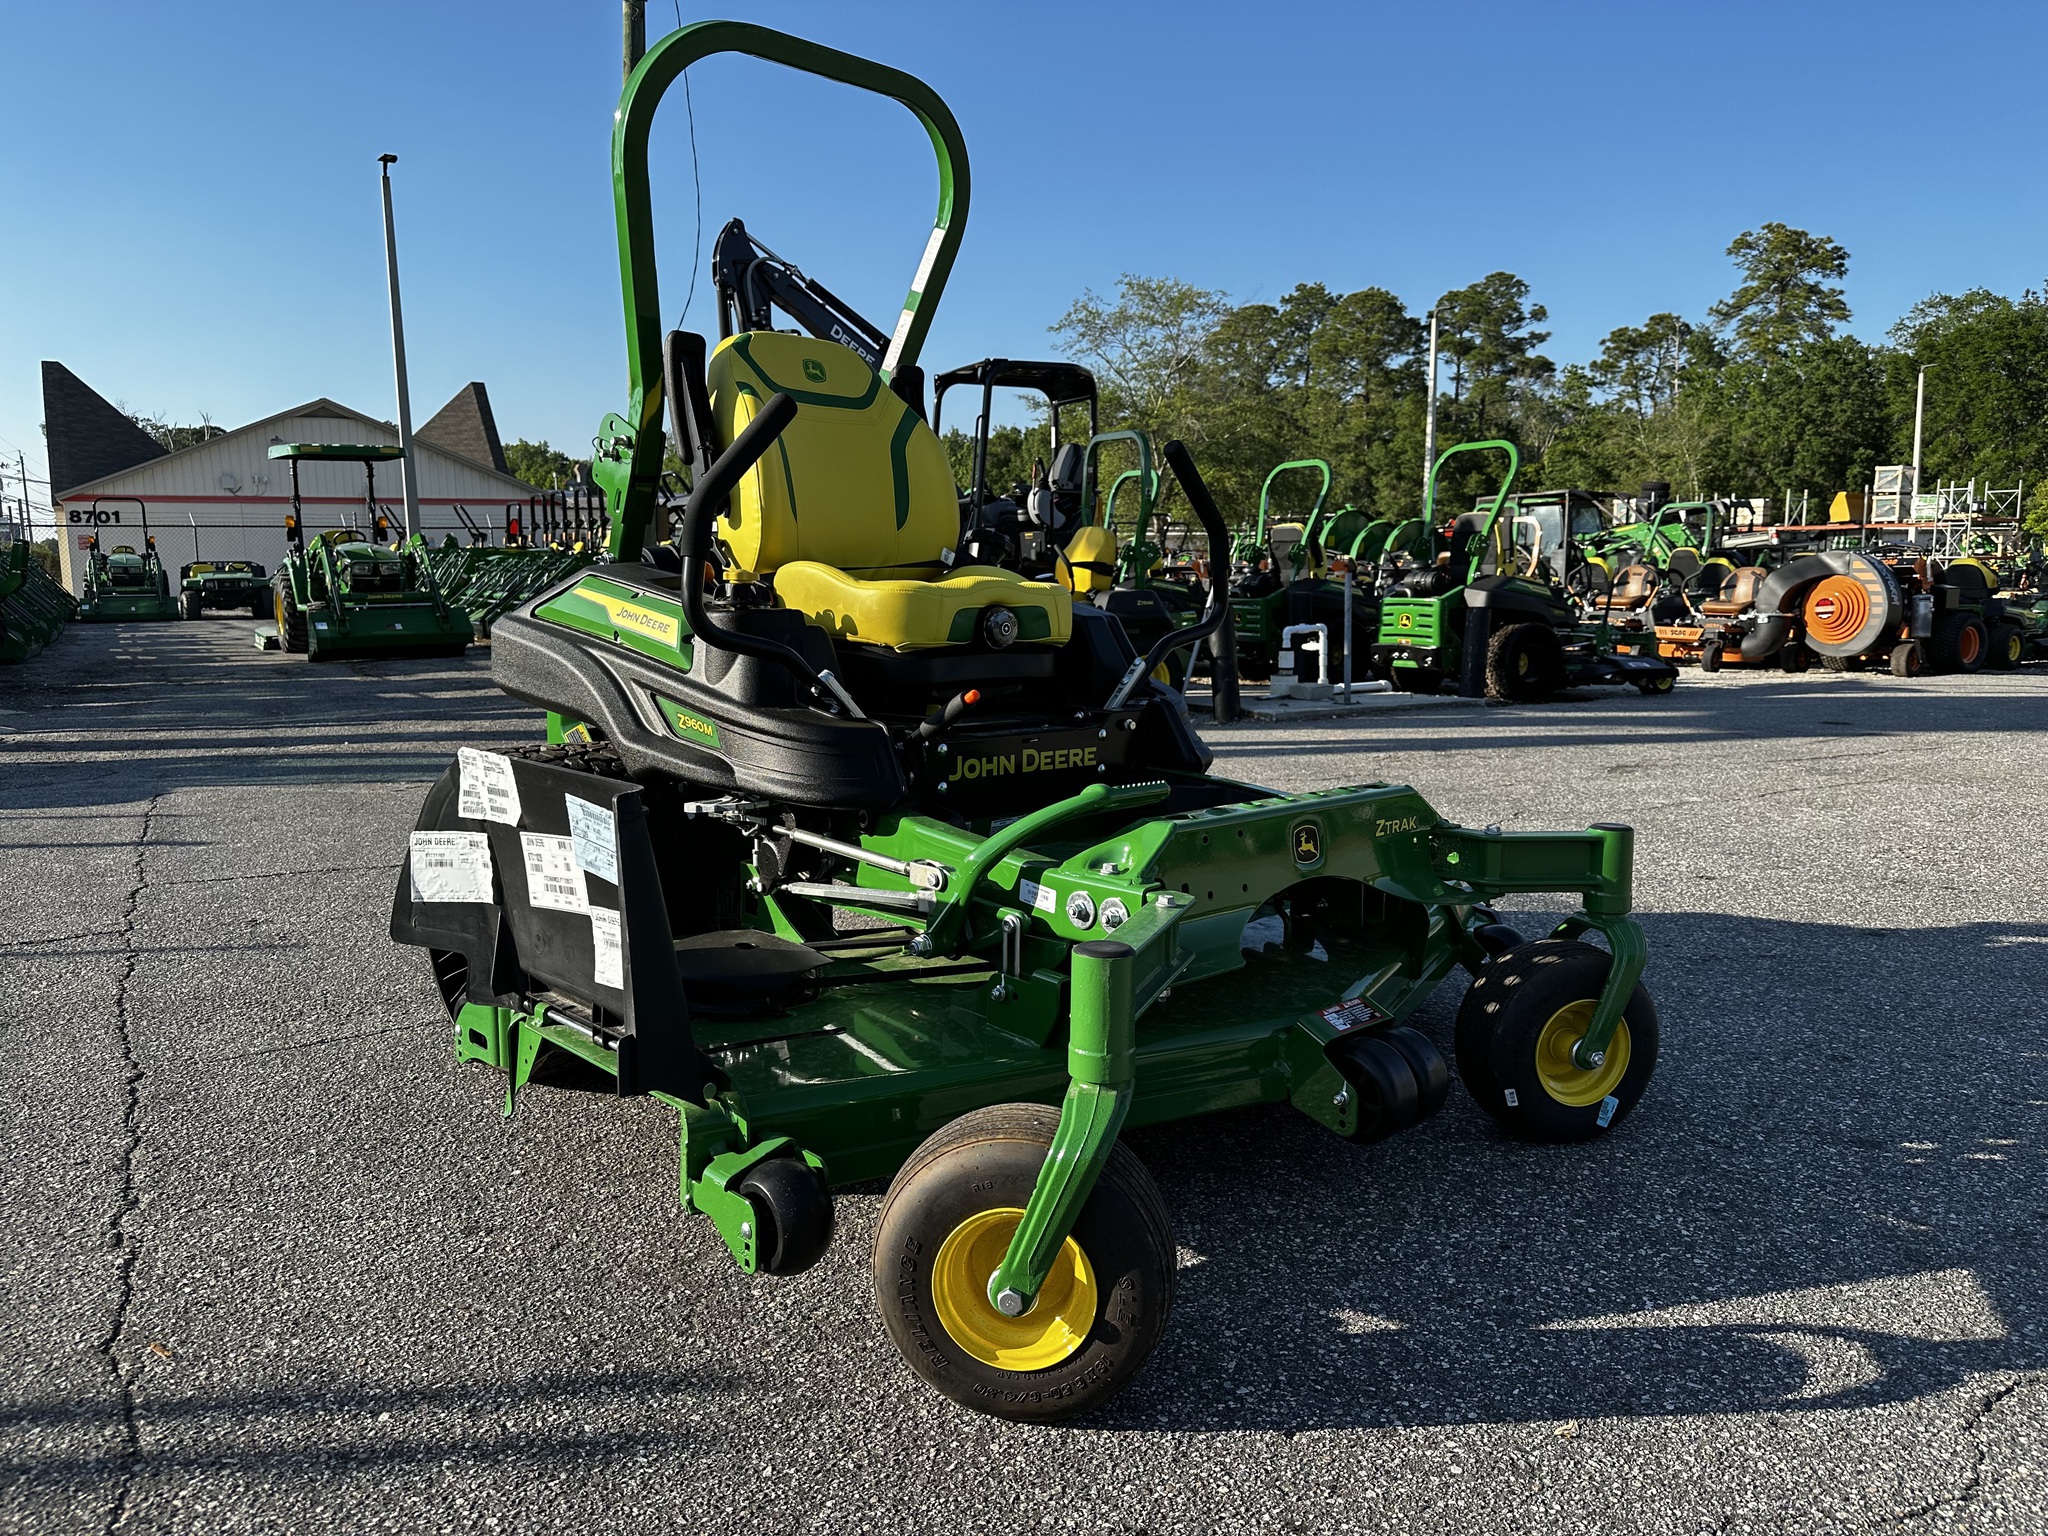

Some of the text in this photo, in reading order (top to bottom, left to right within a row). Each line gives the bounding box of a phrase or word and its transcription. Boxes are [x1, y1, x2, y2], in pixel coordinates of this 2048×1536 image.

[69, 510, 120, 523] 8701
[616, 607, 670, 634] JOHN DEERE
[676, 713, 713, 737] Z960M
[949, 747, 1097, 781] JOHN DEERE
[1375, 816, 1417, 837] ZTRAK
[414, 837, 456, 846] JOHN DEERE
[972, 1180, 993, 1192] RIB
[899, 1235, 950, 1368] RELIANCE
